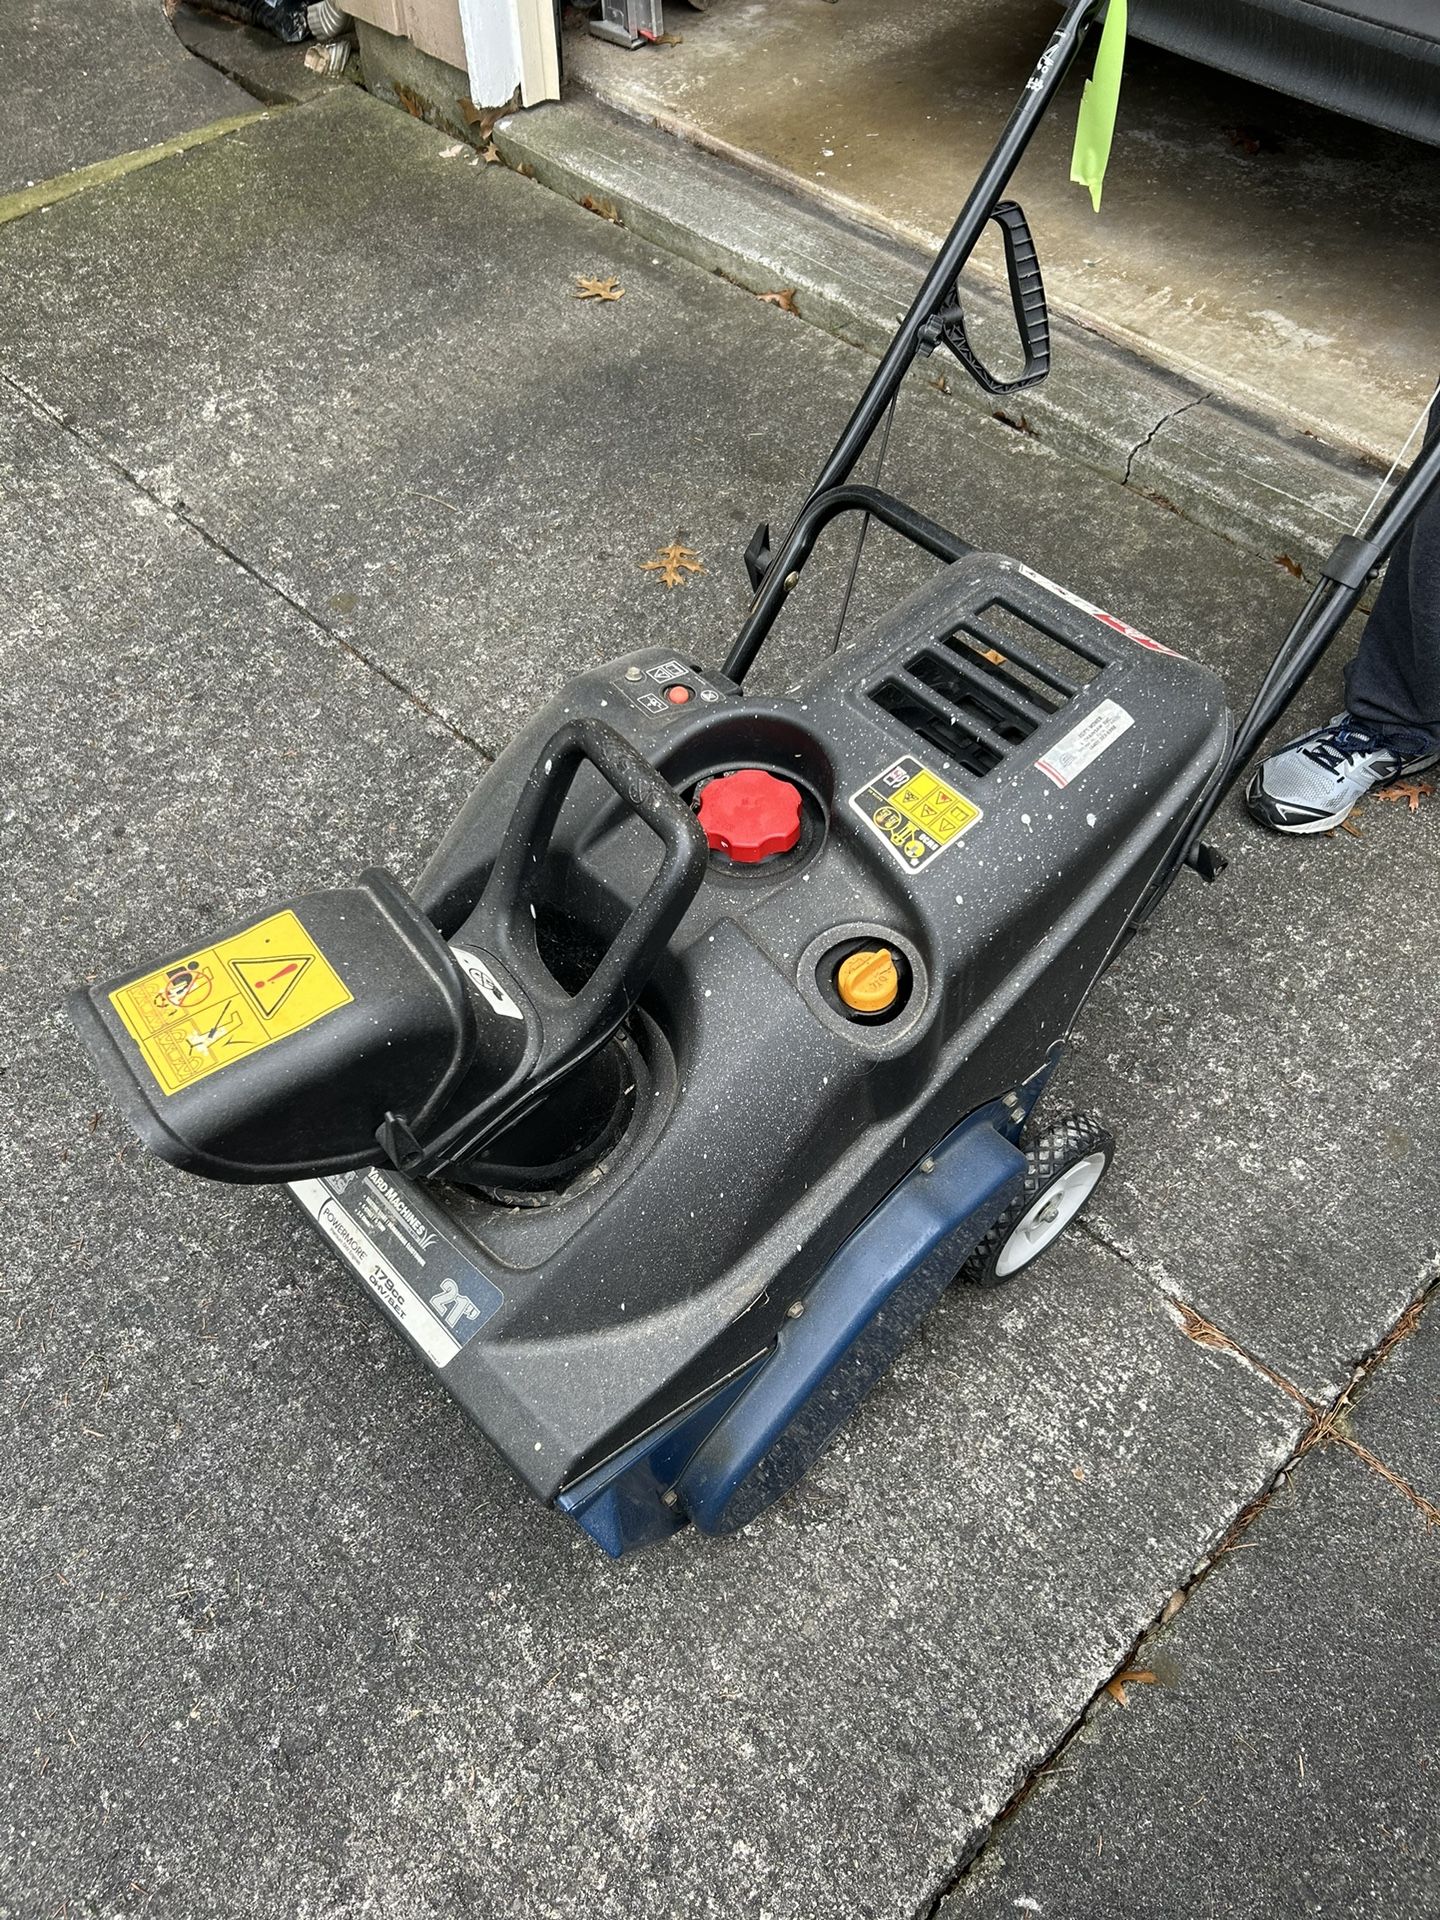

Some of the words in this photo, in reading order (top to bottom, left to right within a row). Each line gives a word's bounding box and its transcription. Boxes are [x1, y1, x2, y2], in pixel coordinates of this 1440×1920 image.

[367, 1166, 388, 1192] YARD
[384, 1187, 426, 1235] MACHINES
[323, 1208, 367, 1260] POWERMORE
[374, 1265, 405, 1305] 179cc
